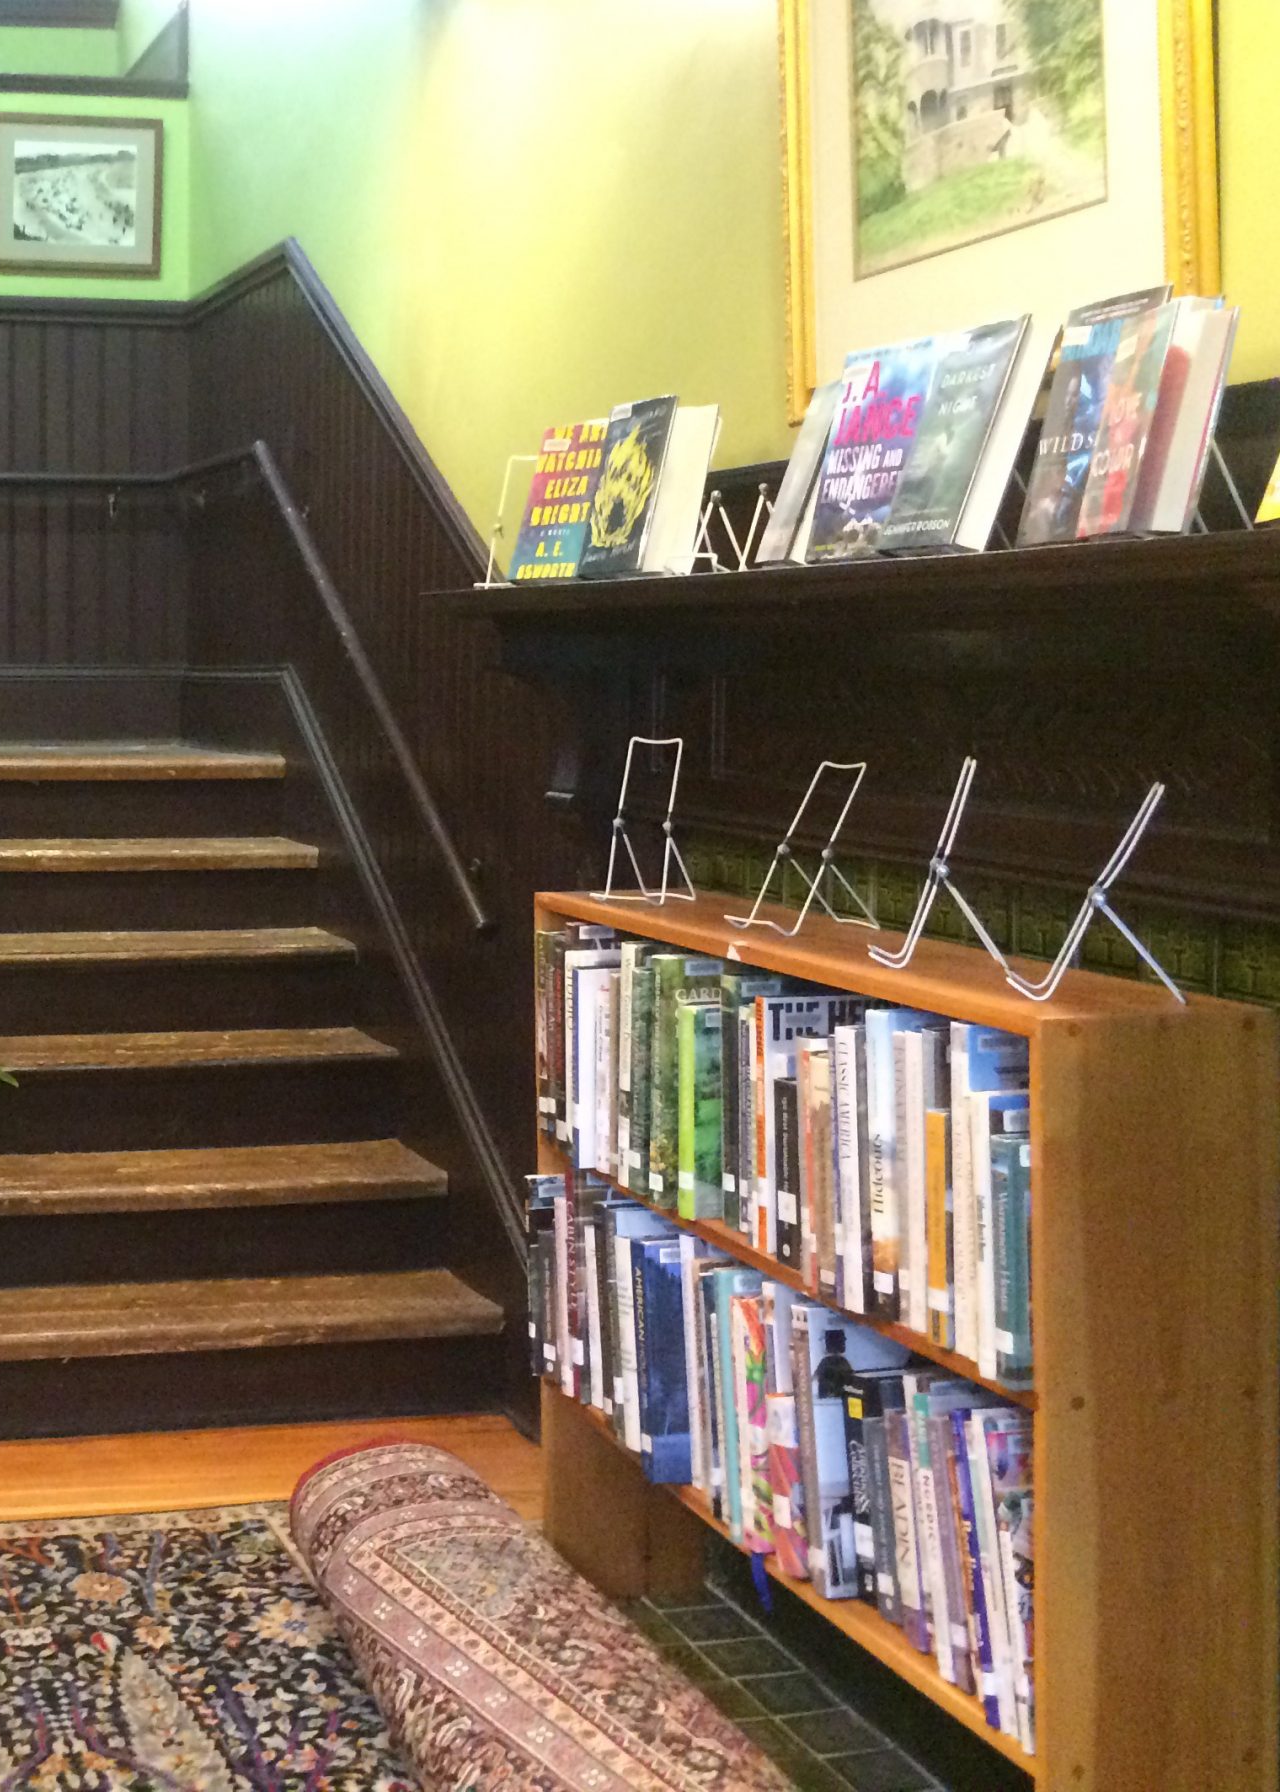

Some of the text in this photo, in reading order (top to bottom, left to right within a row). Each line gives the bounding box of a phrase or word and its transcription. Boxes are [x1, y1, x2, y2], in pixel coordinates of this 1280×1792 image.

[832, 396, 923, 447] JANCE
[826, 443, 904, 475] MISSING AND
[544, 475, 589, 499] ELIZA
[530, 502, 590, 527] BRIGHT
[838, 1041, 849, 1096] CLASSIC
[839, 1101, 852, 1161] AMERICA
[566, 1201, 578, 1311] CABIN STYLE
[635, 1266, 646, 1341] AMERICAN
